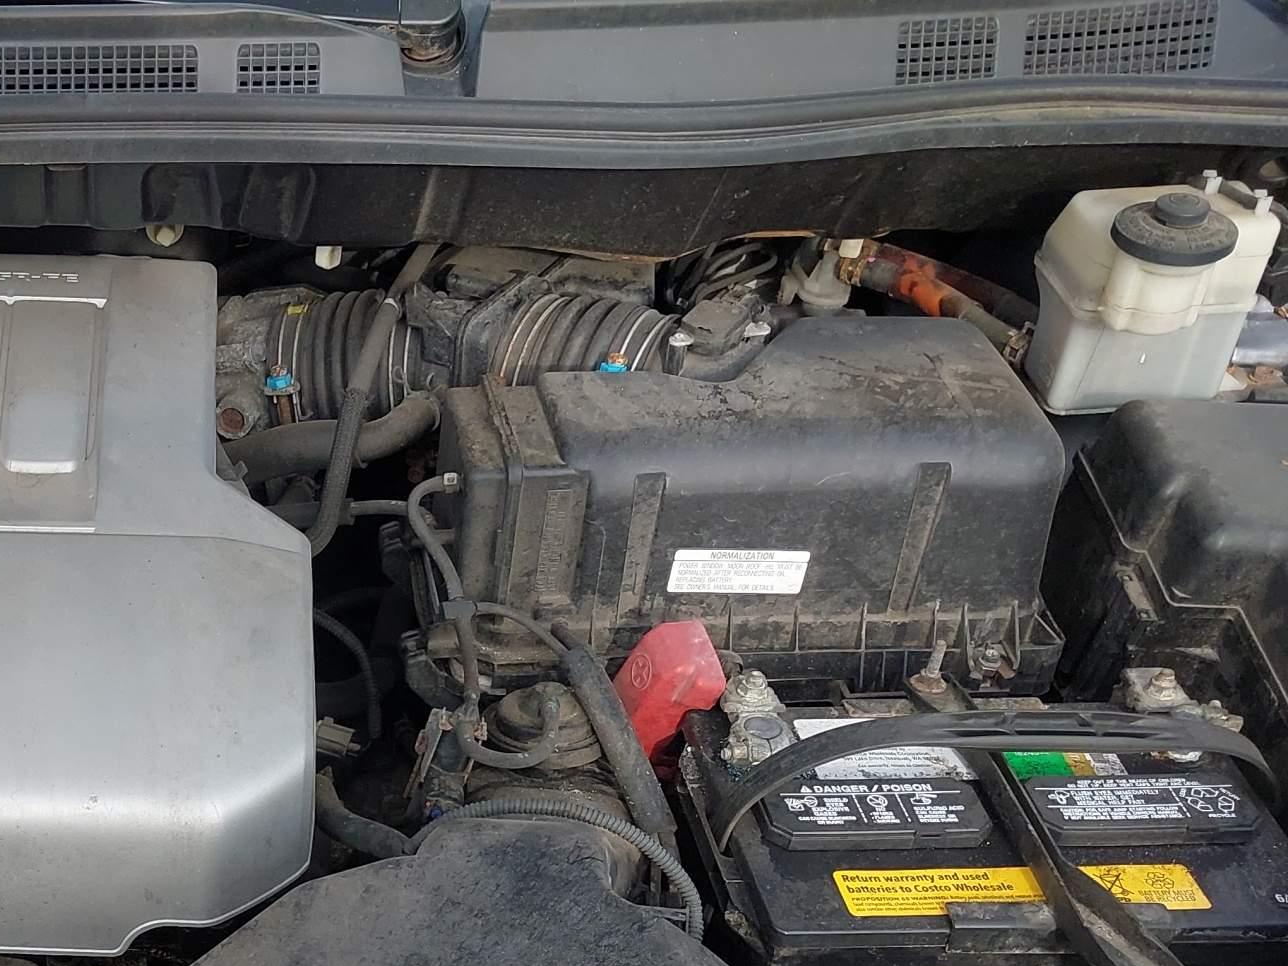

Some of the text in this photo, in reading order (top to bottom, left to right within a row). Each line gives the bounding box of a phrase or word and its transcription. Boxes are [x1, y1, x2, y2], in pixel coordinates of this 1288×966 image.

[710, 552, 774, 561] NORMALIZATION
[841, 872, 990, 884] Return warranty and used
[846, 882, 1014, 893] batteries to Costco Wholesale
